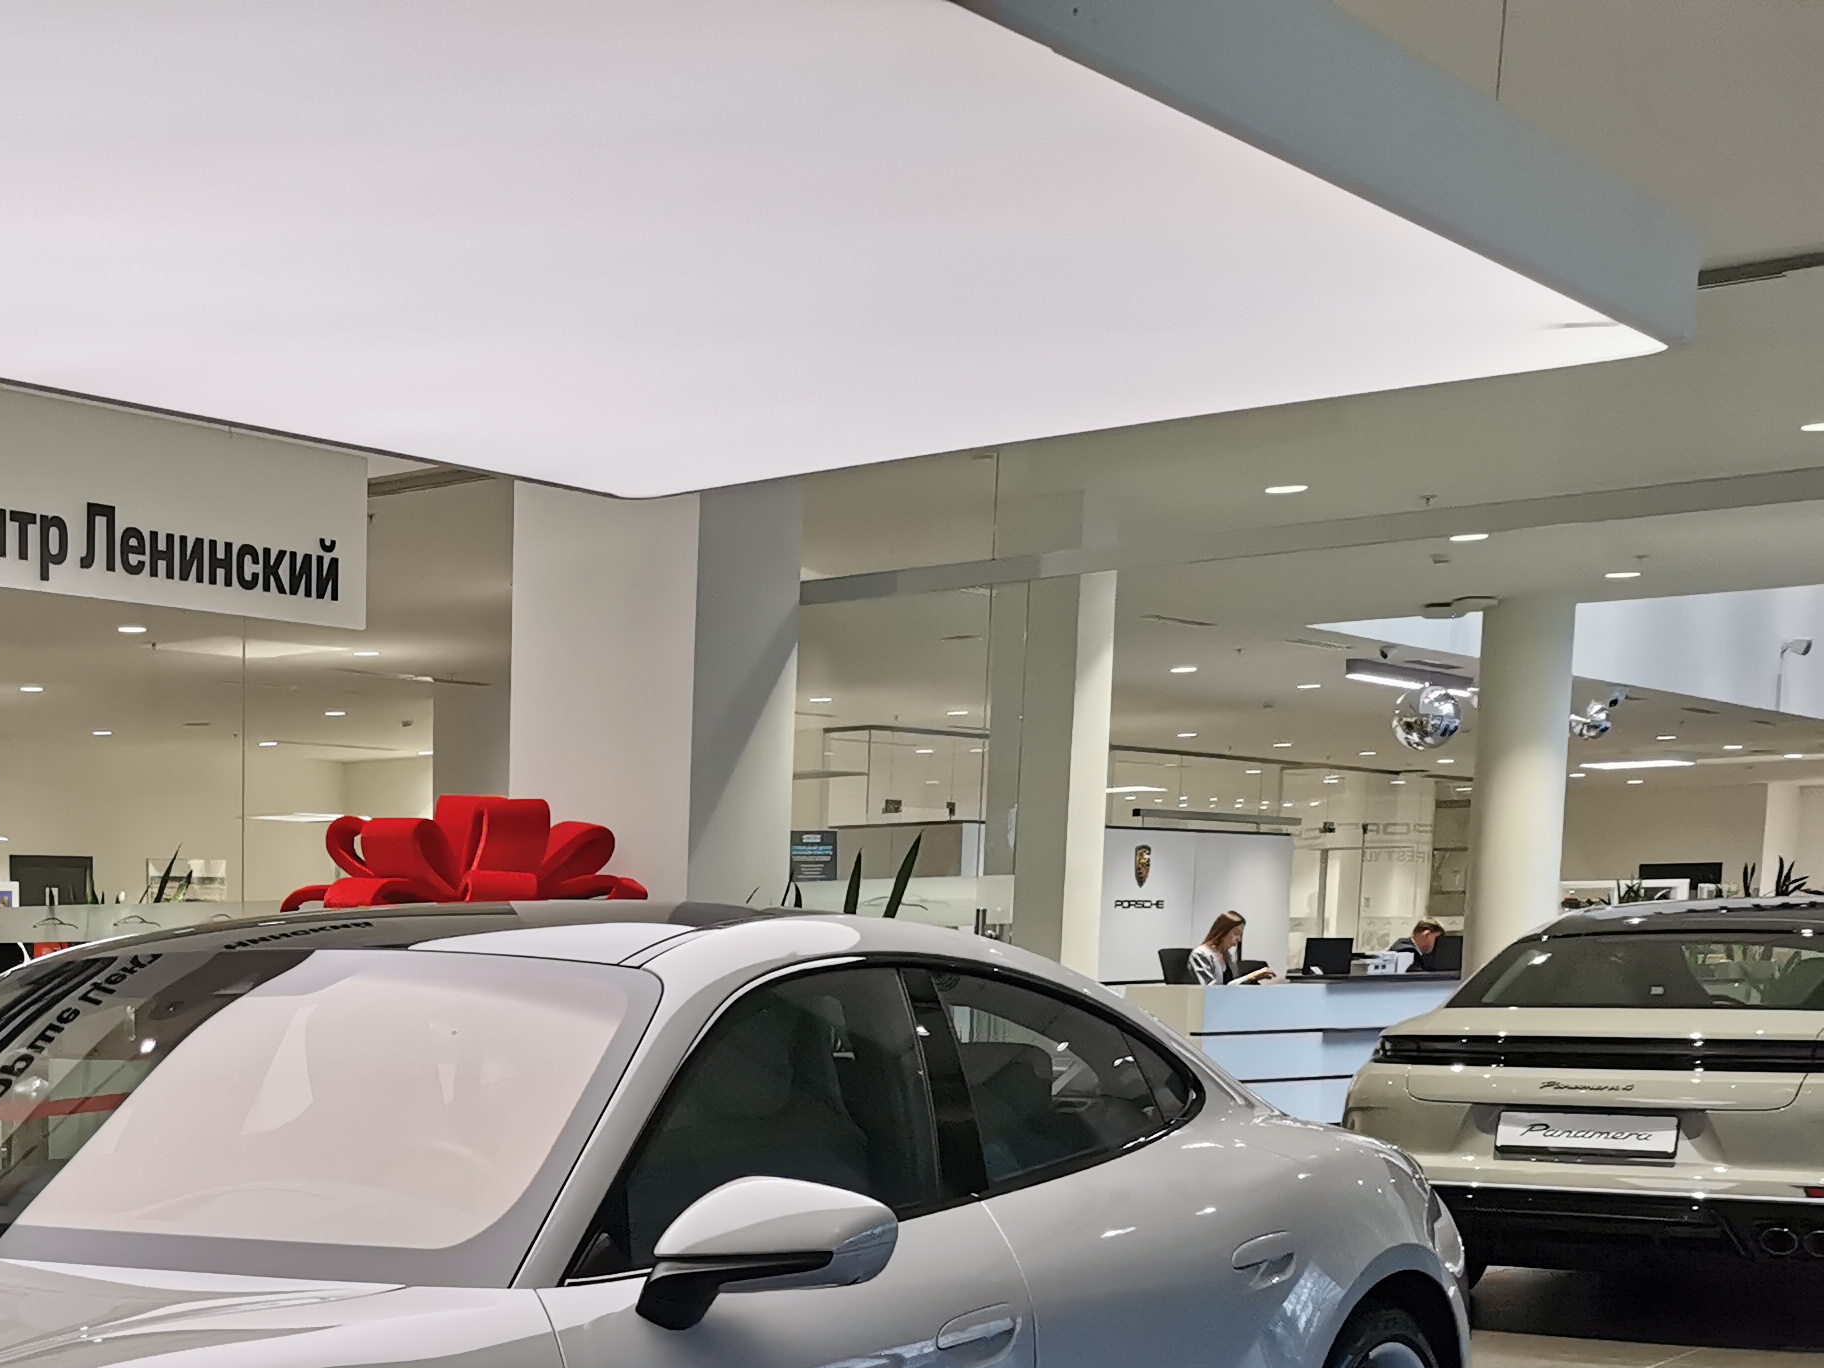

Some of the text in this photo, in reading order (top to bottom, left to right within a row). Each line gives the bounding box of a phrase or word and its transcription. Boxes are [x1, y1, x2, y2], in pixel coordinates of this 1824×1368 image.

[79, 501, 340, 602] Ленинский
[1114, 899, 1164, 909] PORSCHE
[1520, 1122, 1653, 1142] Panamera
